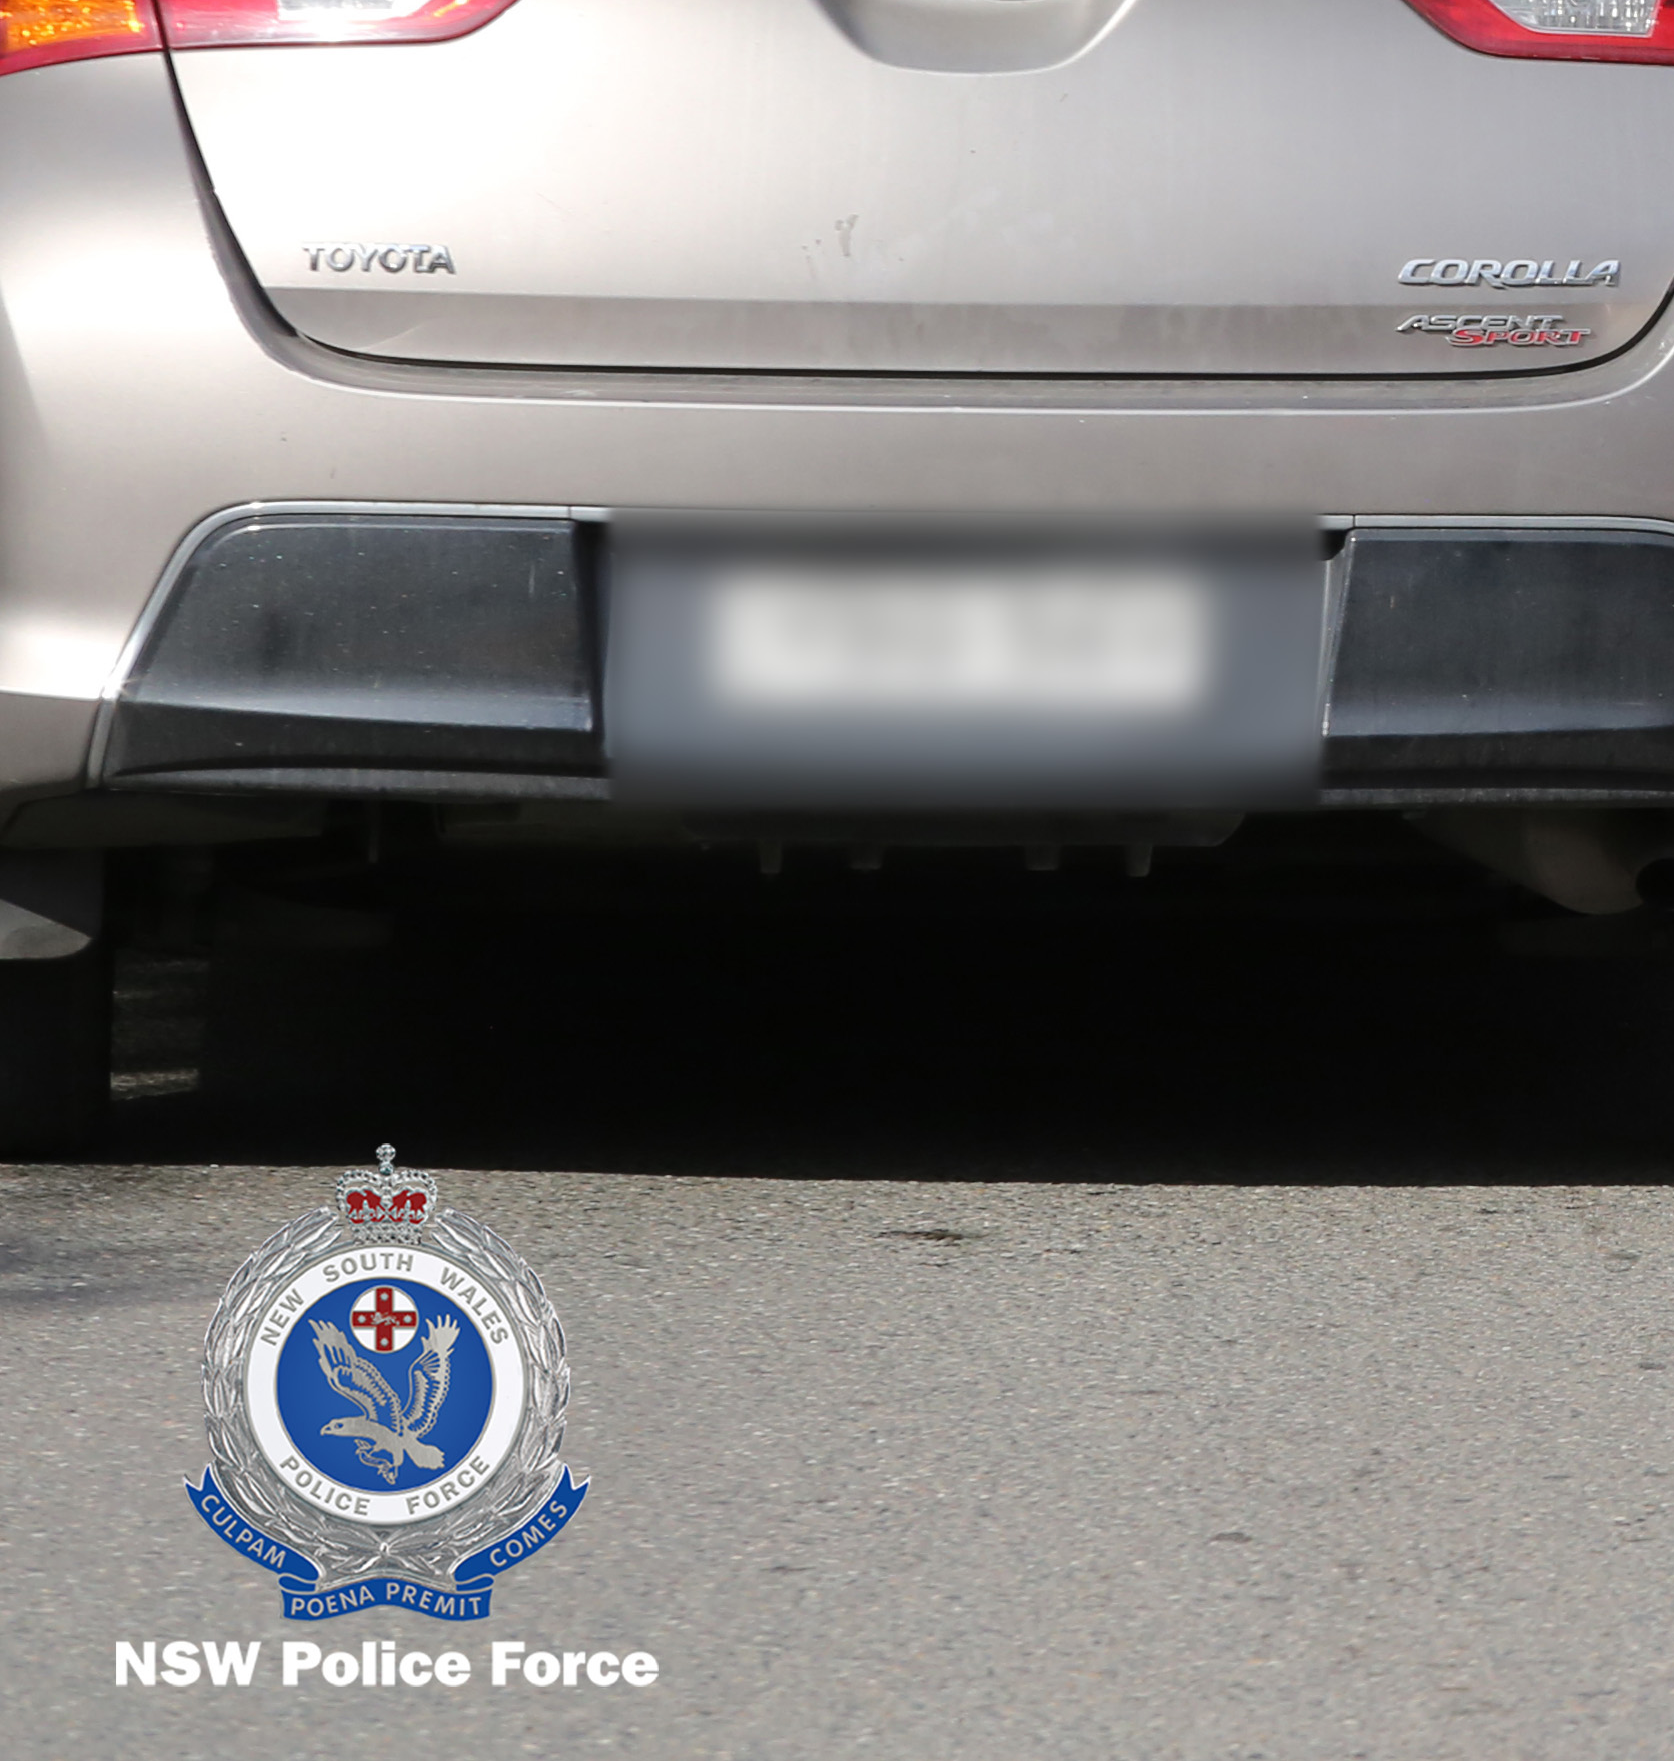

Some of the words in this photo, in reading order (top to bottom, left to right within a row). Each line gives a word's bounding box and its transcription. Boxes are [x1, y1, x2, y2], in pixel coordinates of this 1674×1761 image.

[302, 242, 456, 275] TOYOTA
[1398, 258, 1620, 289] COROLLA
[1395, 314, 1564, 332] ASCENT
[1446, 328, 1591, 347] SPORT
